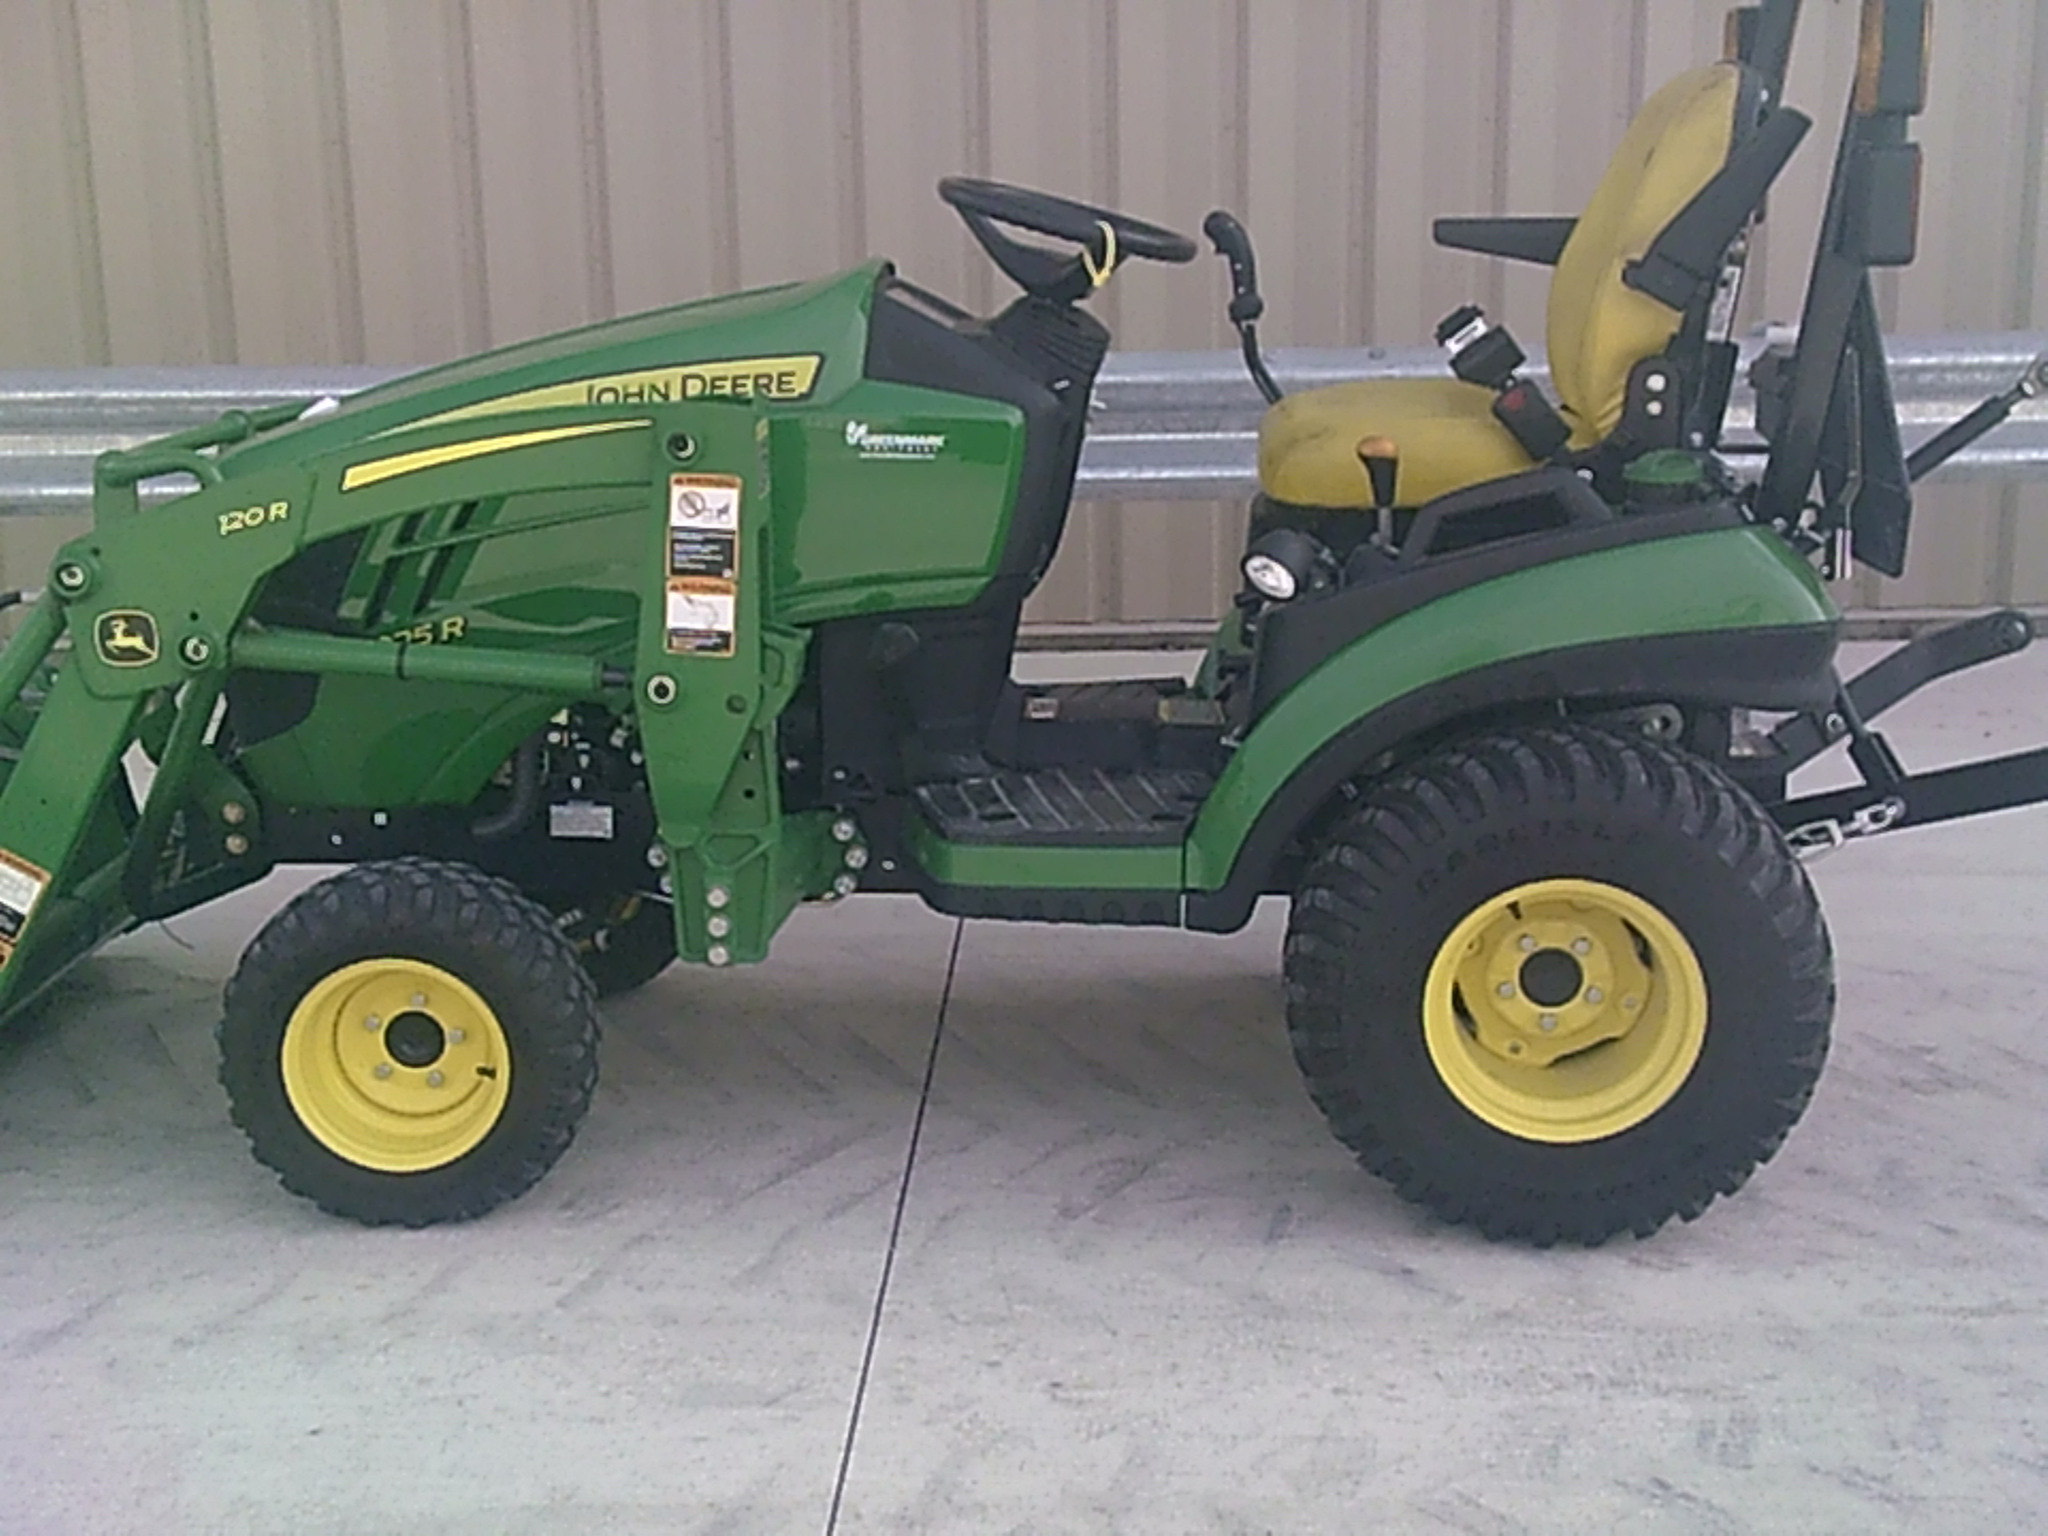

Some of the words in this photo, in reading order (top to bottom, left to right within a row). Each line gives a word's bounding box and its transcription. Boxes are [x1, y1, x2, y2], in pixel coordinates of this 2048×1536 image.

[587, 380, 671, 403] JOHN
[681, 371, 797, 399] DEERE
[219, 506, 265, 536] 120
[269, 501, 289, 522] R
[441, 616, 465, 641] R
